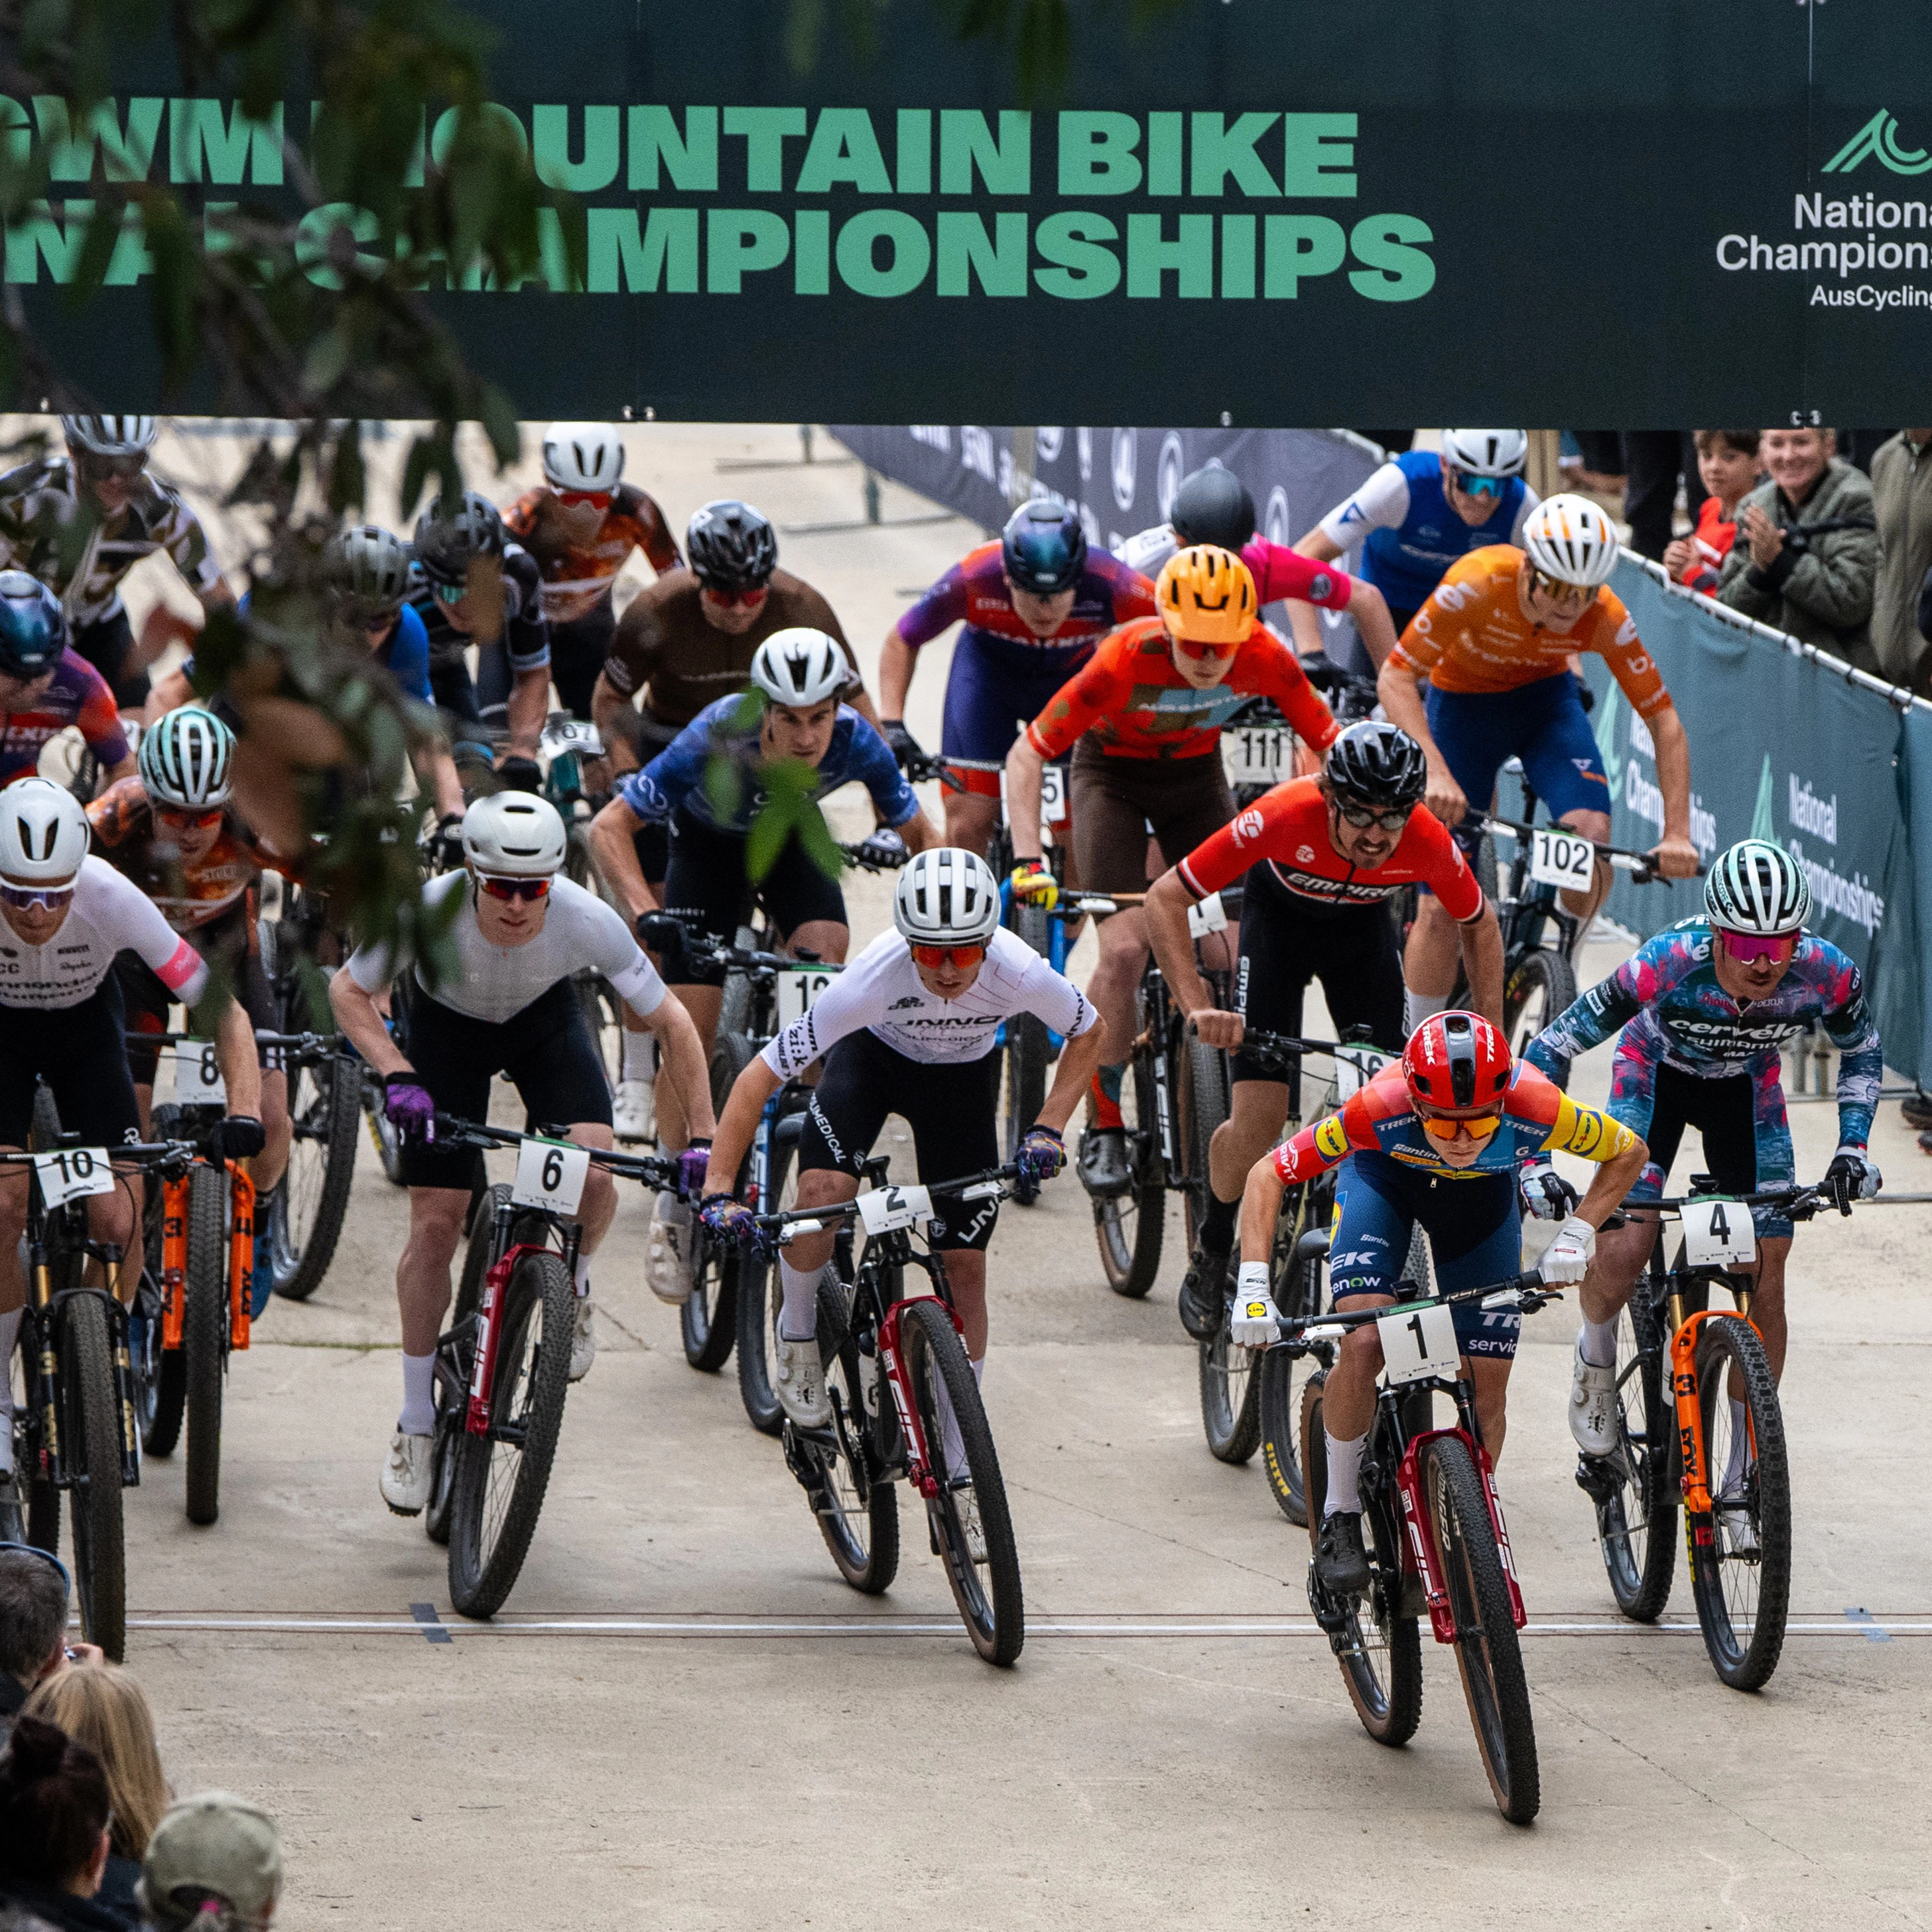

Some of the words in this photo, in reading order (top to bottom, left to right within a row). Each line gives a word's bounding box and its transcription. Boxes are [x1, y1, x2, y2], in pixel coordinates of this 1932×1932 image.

[310, 100, 1031, 195] OUNTAIN
[1058, 110, 1358, 197] BIKE
[1795, 192, 1932, 229] Nation
[1716, 233, 1932, 278] Champion
[1810, 284, 1932, 312] AusCyclin
[1242, 731, 1281, 767] 111
[1539, 836, 1589, 876] 102
[1422, 1023, 1436, 1065] TREK
[1484, 1021, 1495, 1063] TREK
[1667, 1019, 1803, 1040] cervélo
[200, 1046, 220, 1086] 8
[1376, 1114, 1417, 1131] TREK
[1504, 1119, 1549, 1137] TREK
[51, 1150, 94, 1184] 10
[541, 1149, 564, 1192] 6
[1393, 1143, 1441, 1161] Santini
[879, 1185, 907, 1213] 2
[1360, 1233, 1391, 1248] Santini
[1709, 1203, 1732, 1246] 4
[1406, 1313, 1429, 1360] 1
